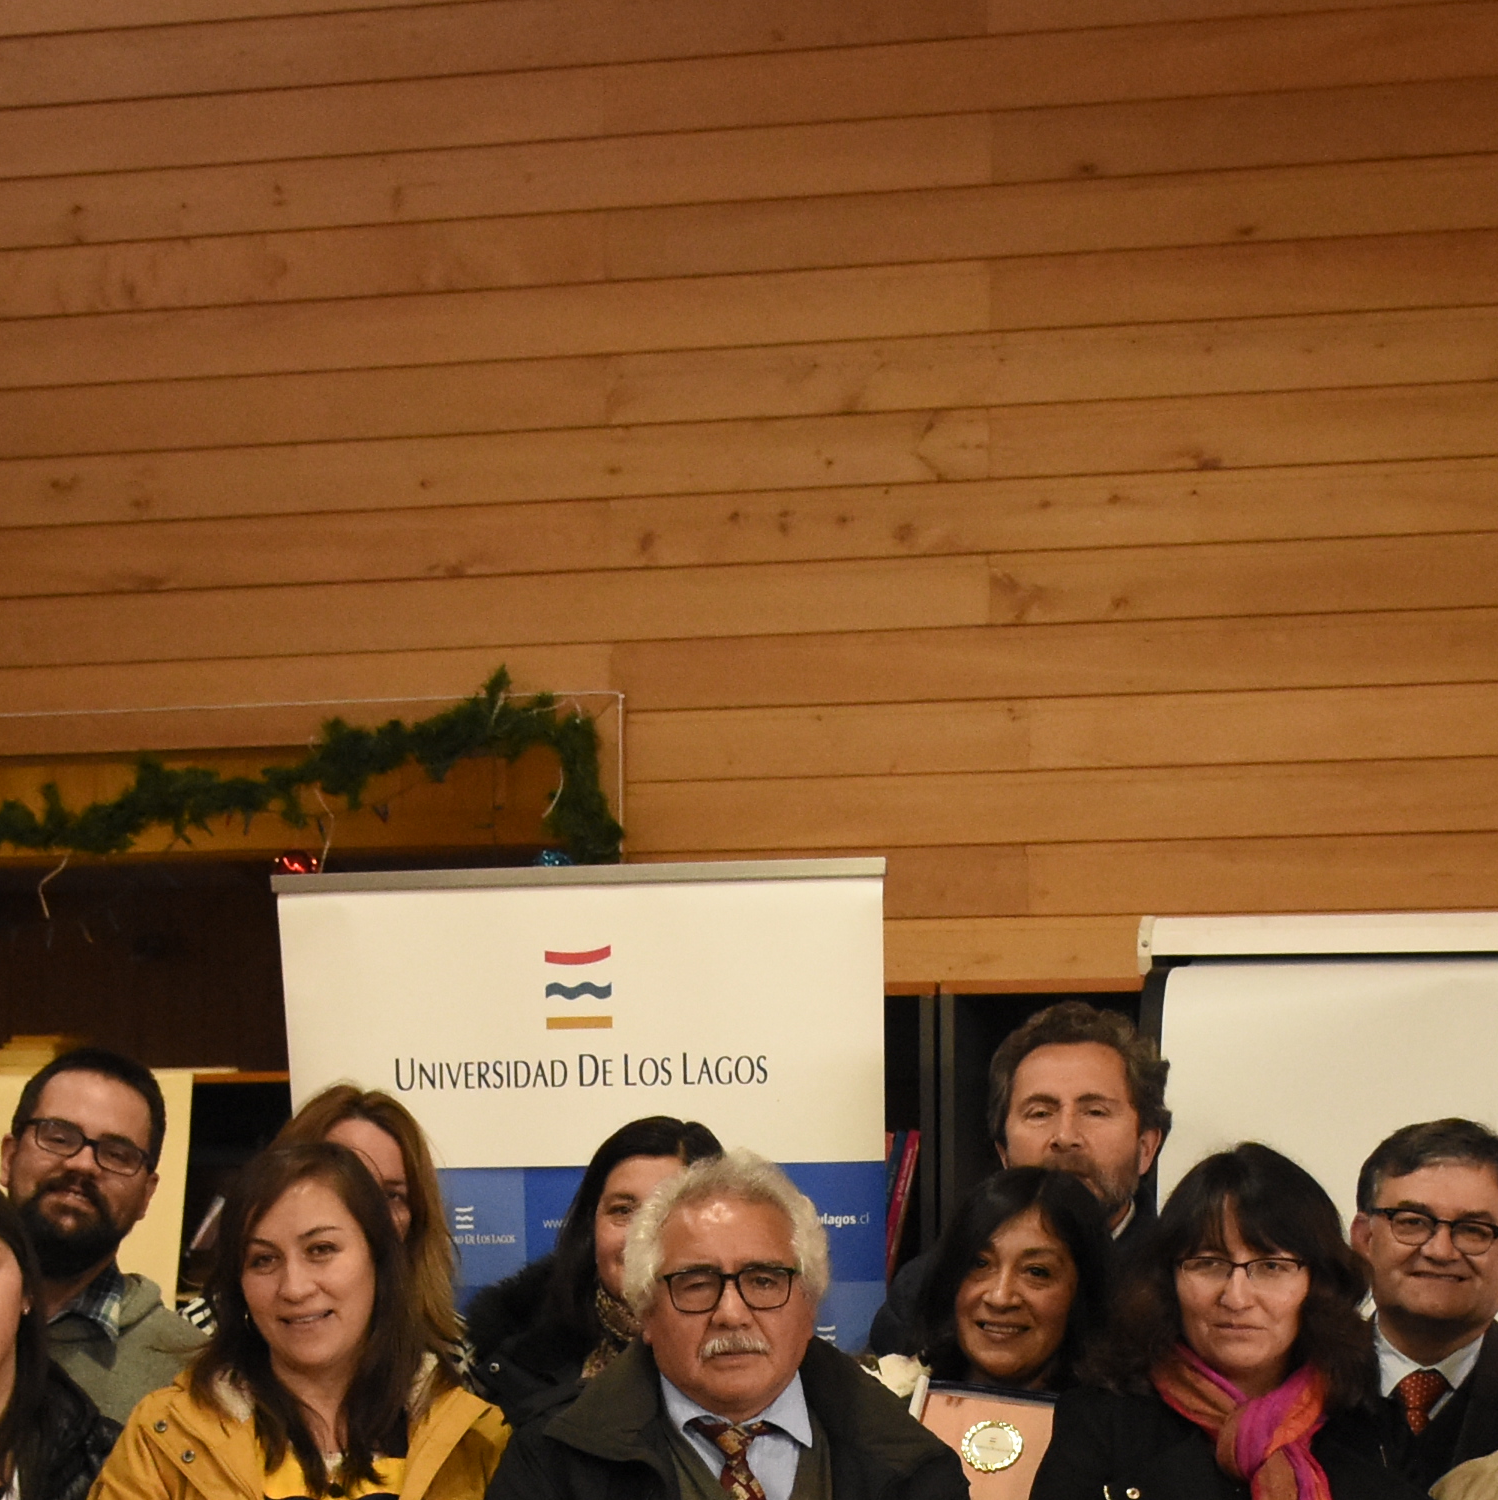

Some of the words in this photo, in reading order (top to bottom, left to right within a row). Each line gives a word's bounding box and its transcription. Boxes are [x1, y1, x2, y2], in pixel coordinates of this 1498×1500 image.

[395, 1058, 568, 1091] UNIVERSIDAD
[578, 1053, 614, 1088] DE
[624, 1053, 673, 1087] LOS
[683, 1052, 769, 1086] LAGOS
